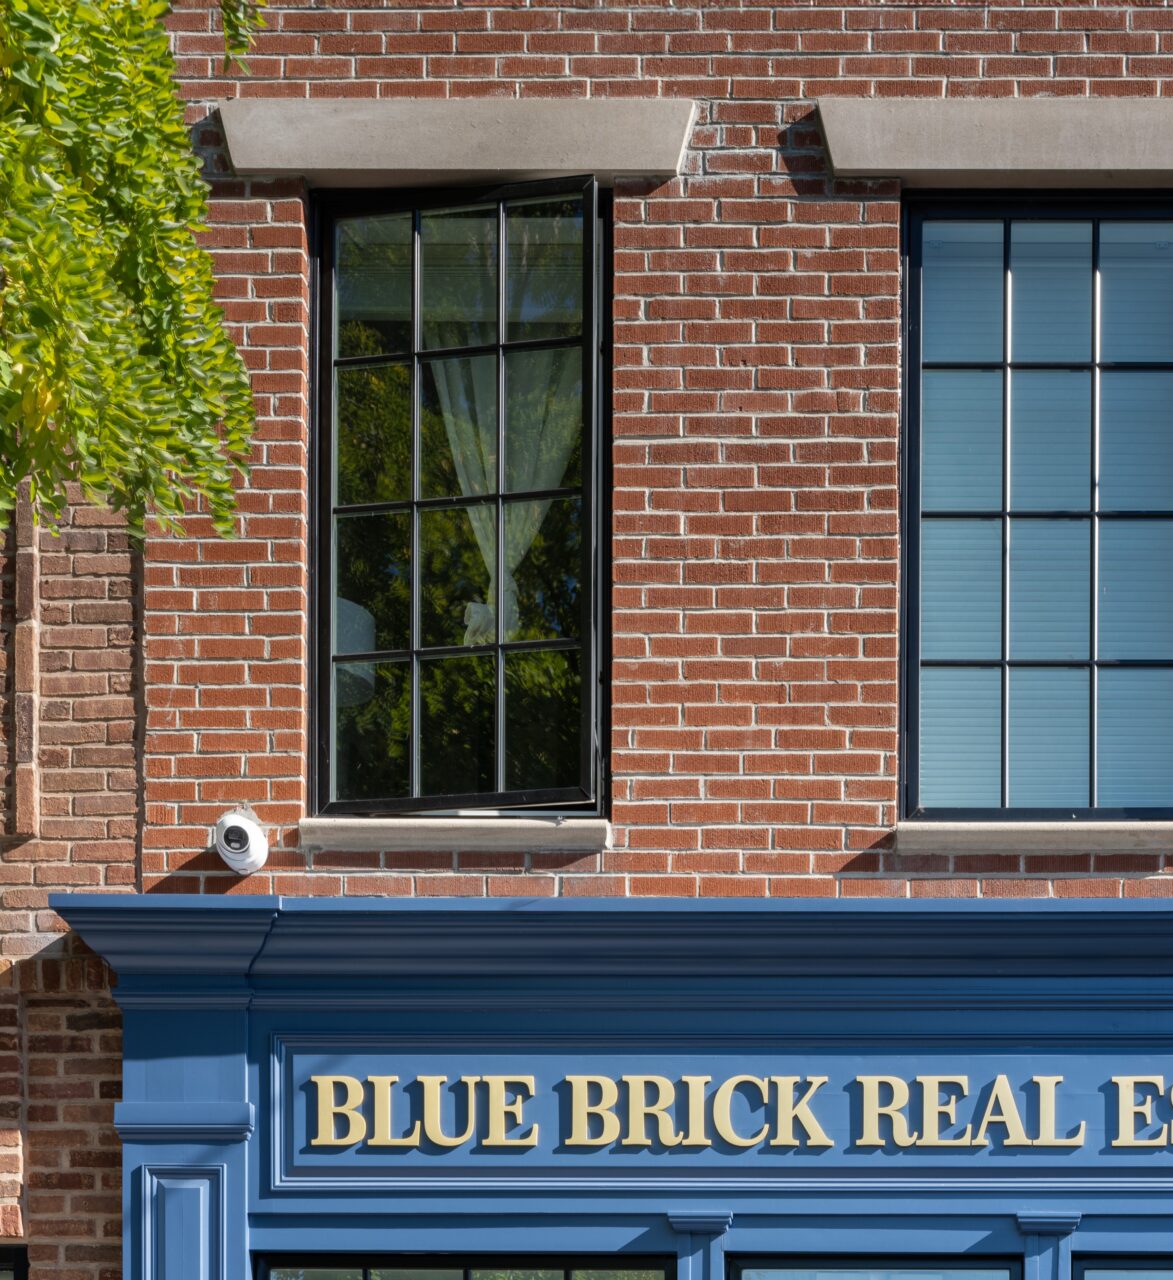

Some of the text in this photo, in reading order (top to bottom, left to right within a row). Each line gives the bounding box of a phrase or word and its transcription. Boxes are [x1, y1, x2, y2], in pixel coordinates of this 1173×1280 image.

[310, 1075, 539, 1147] BLUE
[564, 1074, 834, 1147] BRICK
[855, 1074, 1086, 1147] REAL
